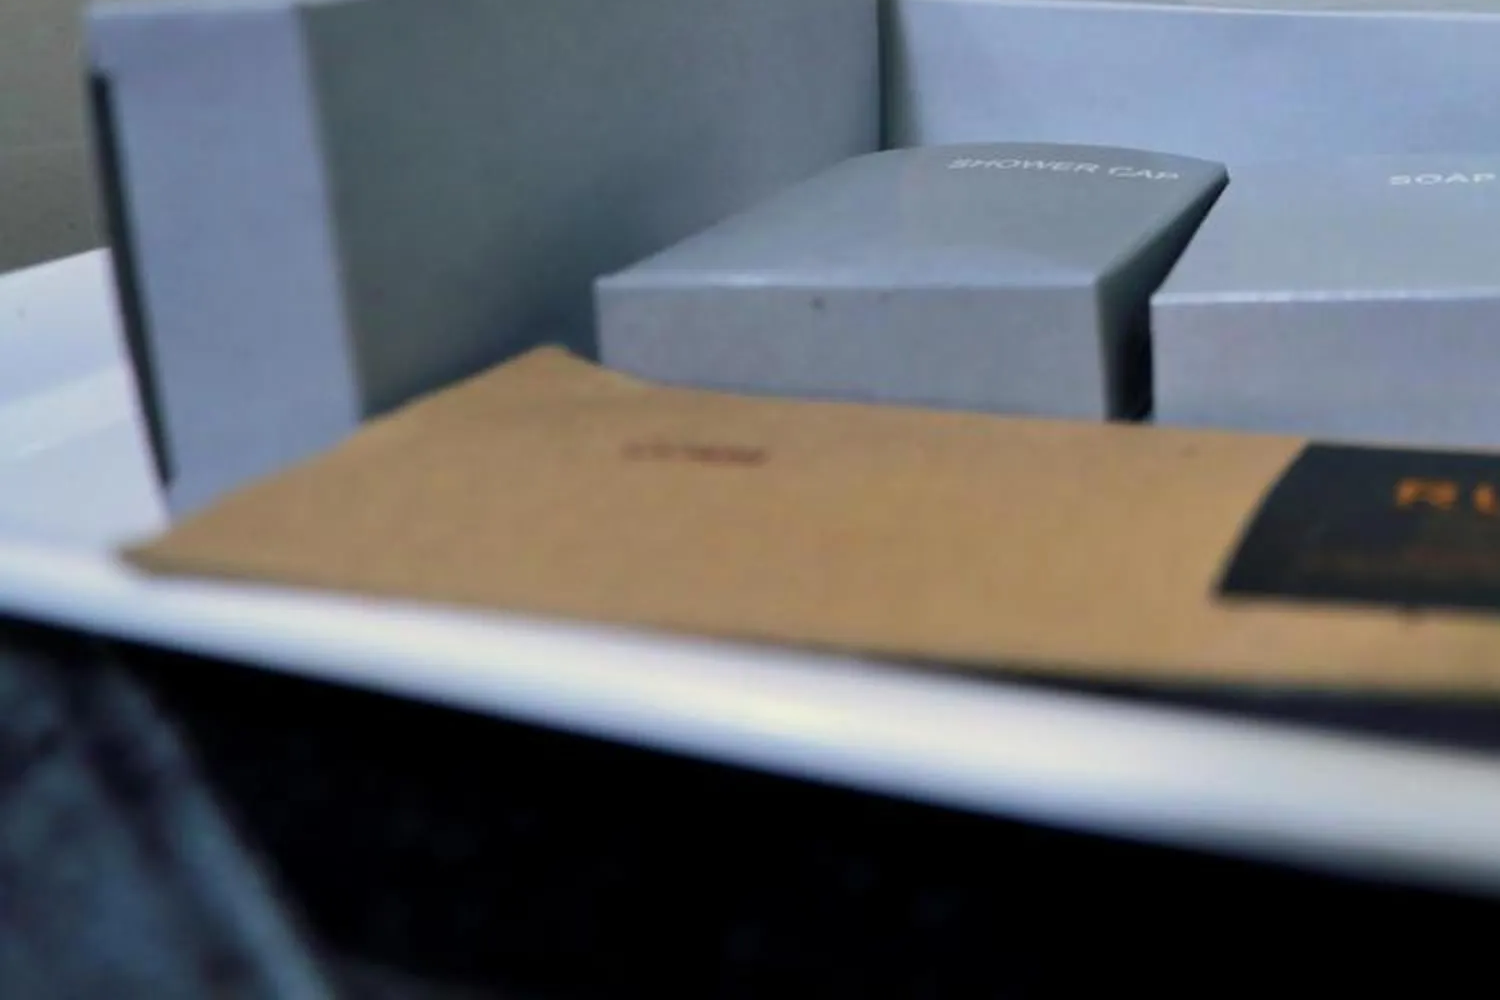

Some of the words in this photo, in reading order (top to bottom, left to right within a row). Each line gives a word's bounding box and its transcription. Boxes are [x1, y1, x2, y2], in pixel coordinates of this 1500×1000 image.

[948, 157, 1100, 174] SHOWER
[1108, 166, 1180, 180] CAP
[1390, 172, 1497, 186] SOAP
